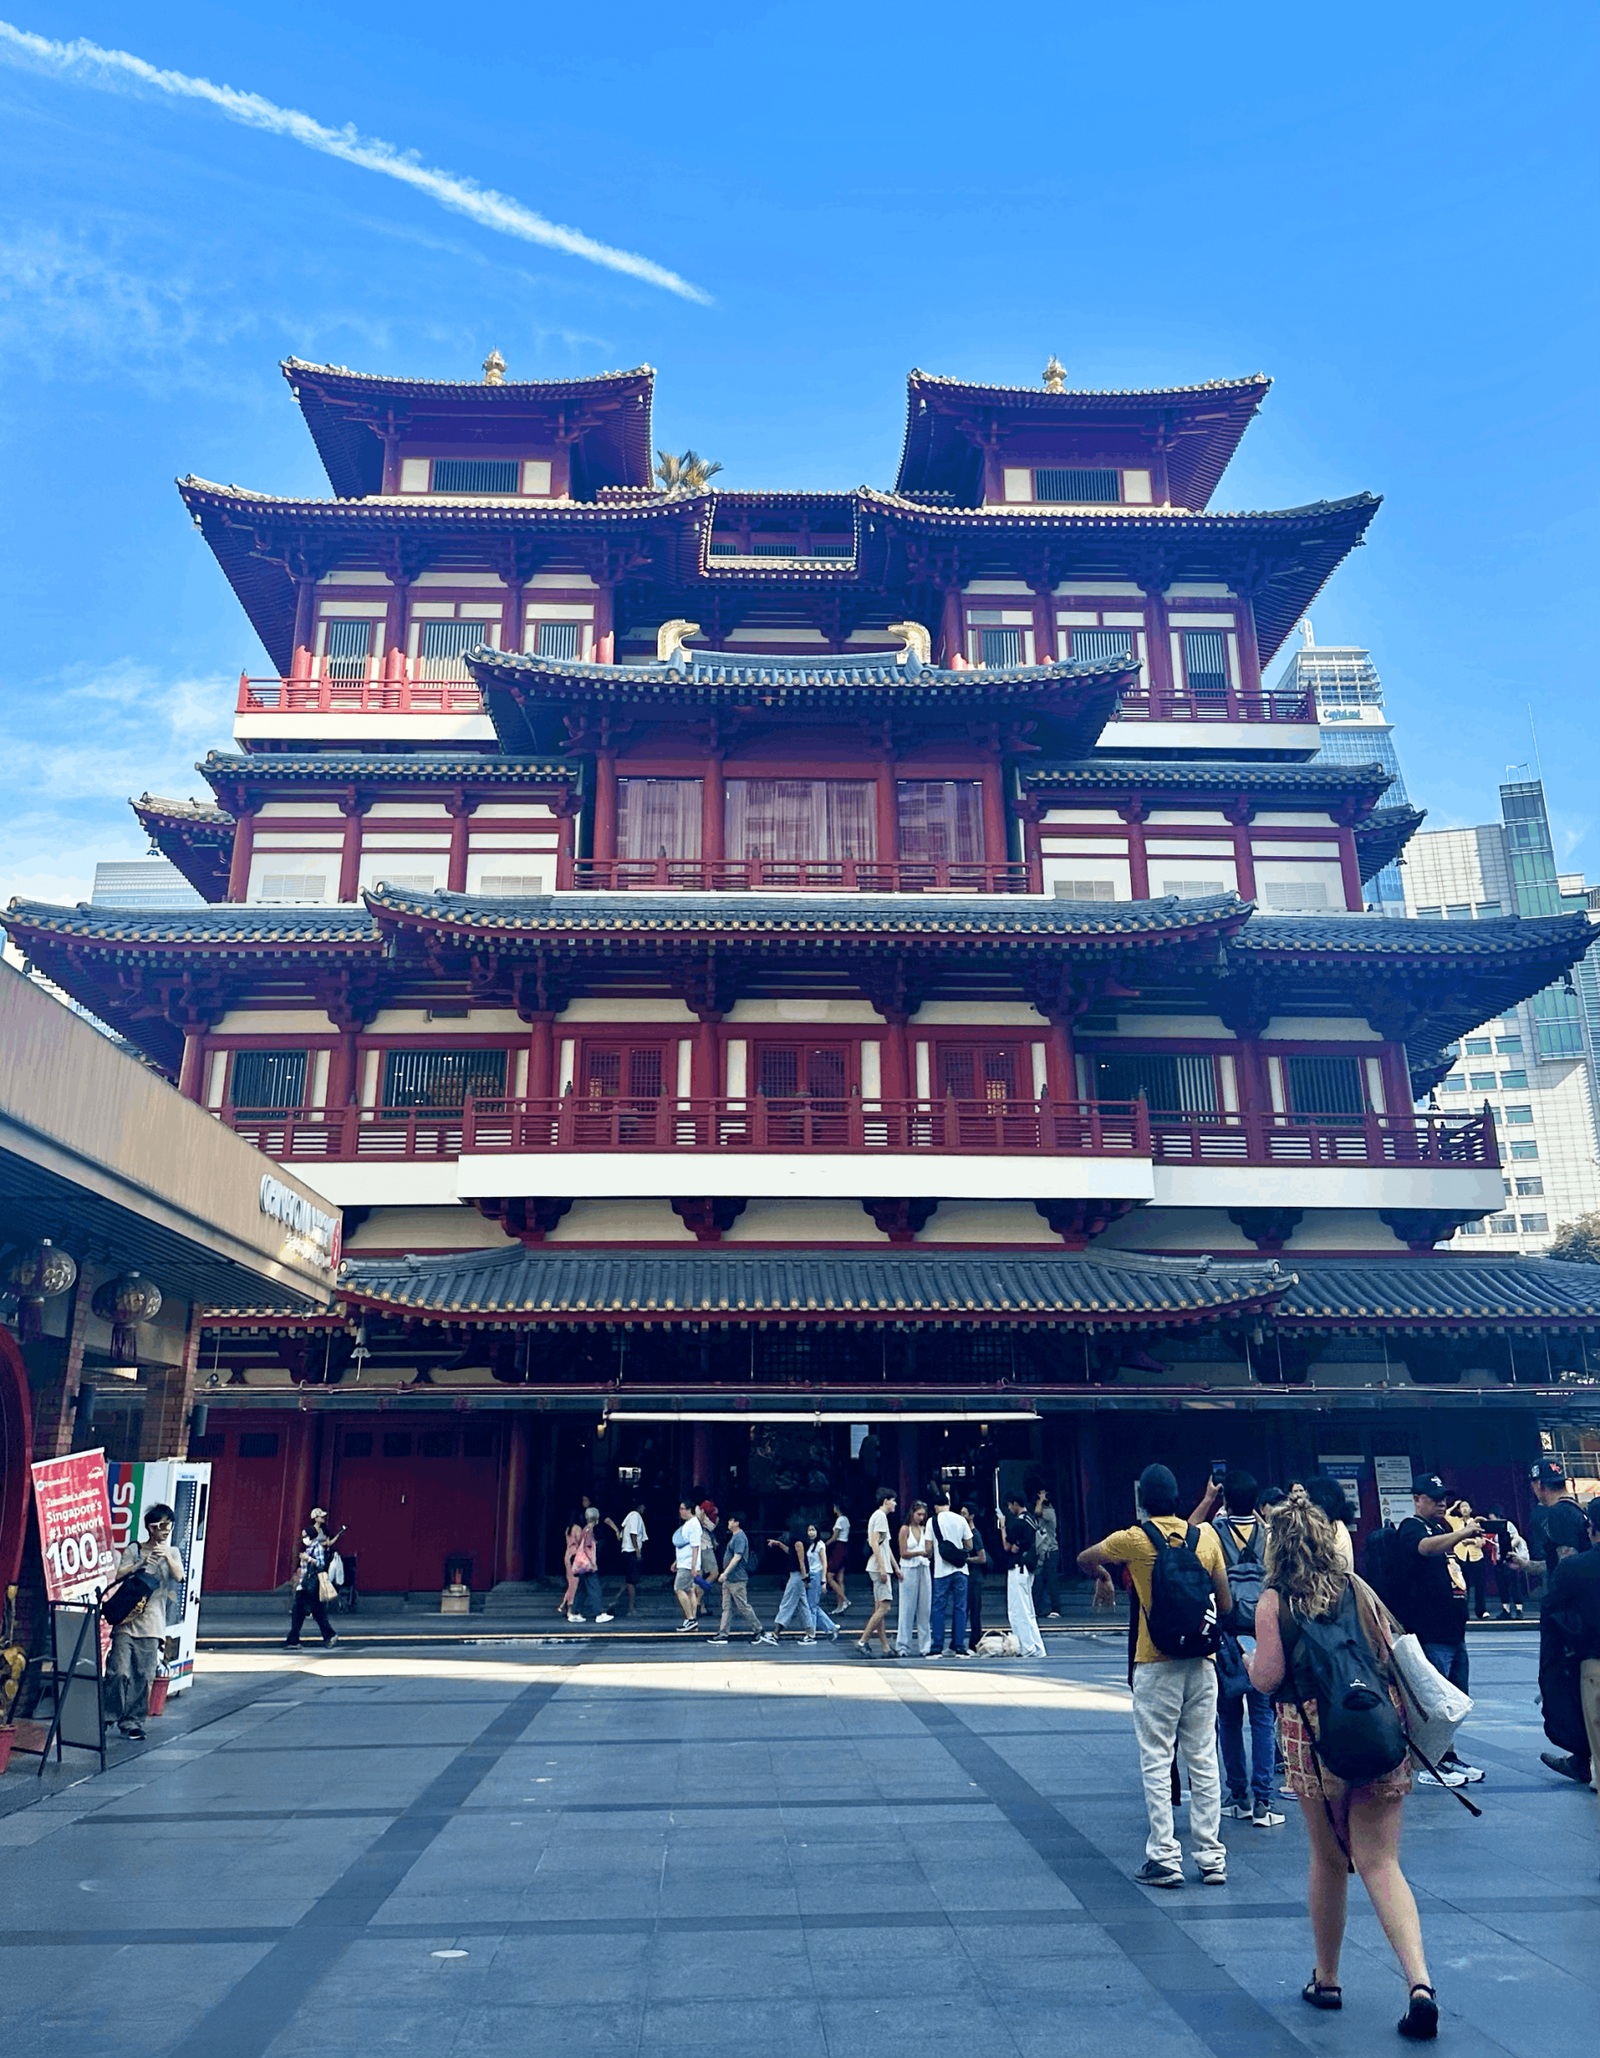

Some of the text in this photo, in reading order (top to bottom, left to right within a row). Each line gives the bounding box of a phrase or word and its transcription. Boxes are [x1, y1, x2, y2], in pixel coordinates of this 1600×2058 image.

[1323, 708, 1361, 721] CapitaLand
[46, 1499, 103, 1523] Singapore's
[112, 1481, 136, 1550] LUS
[49, 1514, 104, 1539] #1 network
[1202, 1593, 1217, 1635] FILA
